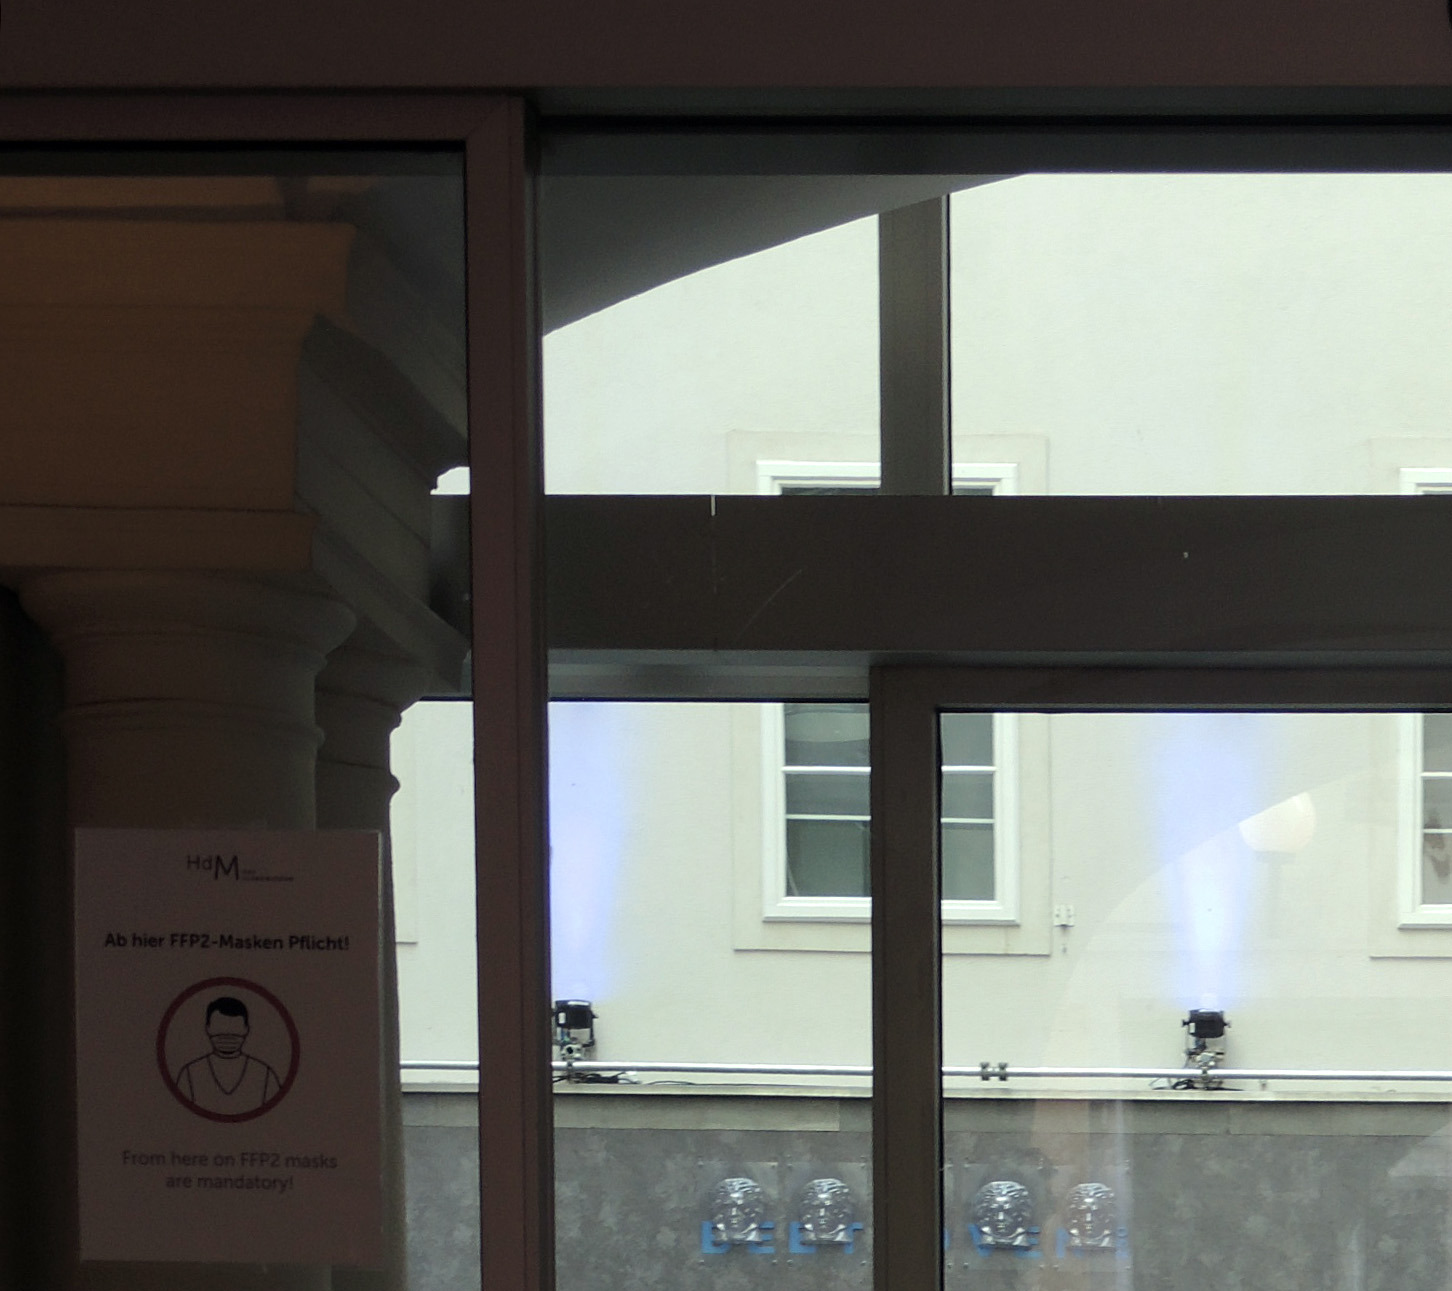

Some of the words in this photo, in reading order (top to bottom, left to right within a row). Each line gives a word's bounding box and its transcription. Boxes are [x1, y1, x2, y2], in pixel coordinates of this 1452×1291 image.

[185, 855, 239, 880] HdM
[104, 933, 127, 947] Ab
[132, 933, 164, 947] hier
[170, 933, 283, 949] FFP2-Masken
[288, 935, 350, 950] Pflicht!
[121, 1150, 165, 1166] From
[171, 1151, 208, 1166] here
[213, 1154, 235, 1167] on
[240, 1152, 280, 1167] FFP2
[285, 1153, 338, 1168] masks
[166, 1176, 192, 1188] are
[197, 1175, 294, 1193] mandatory!
